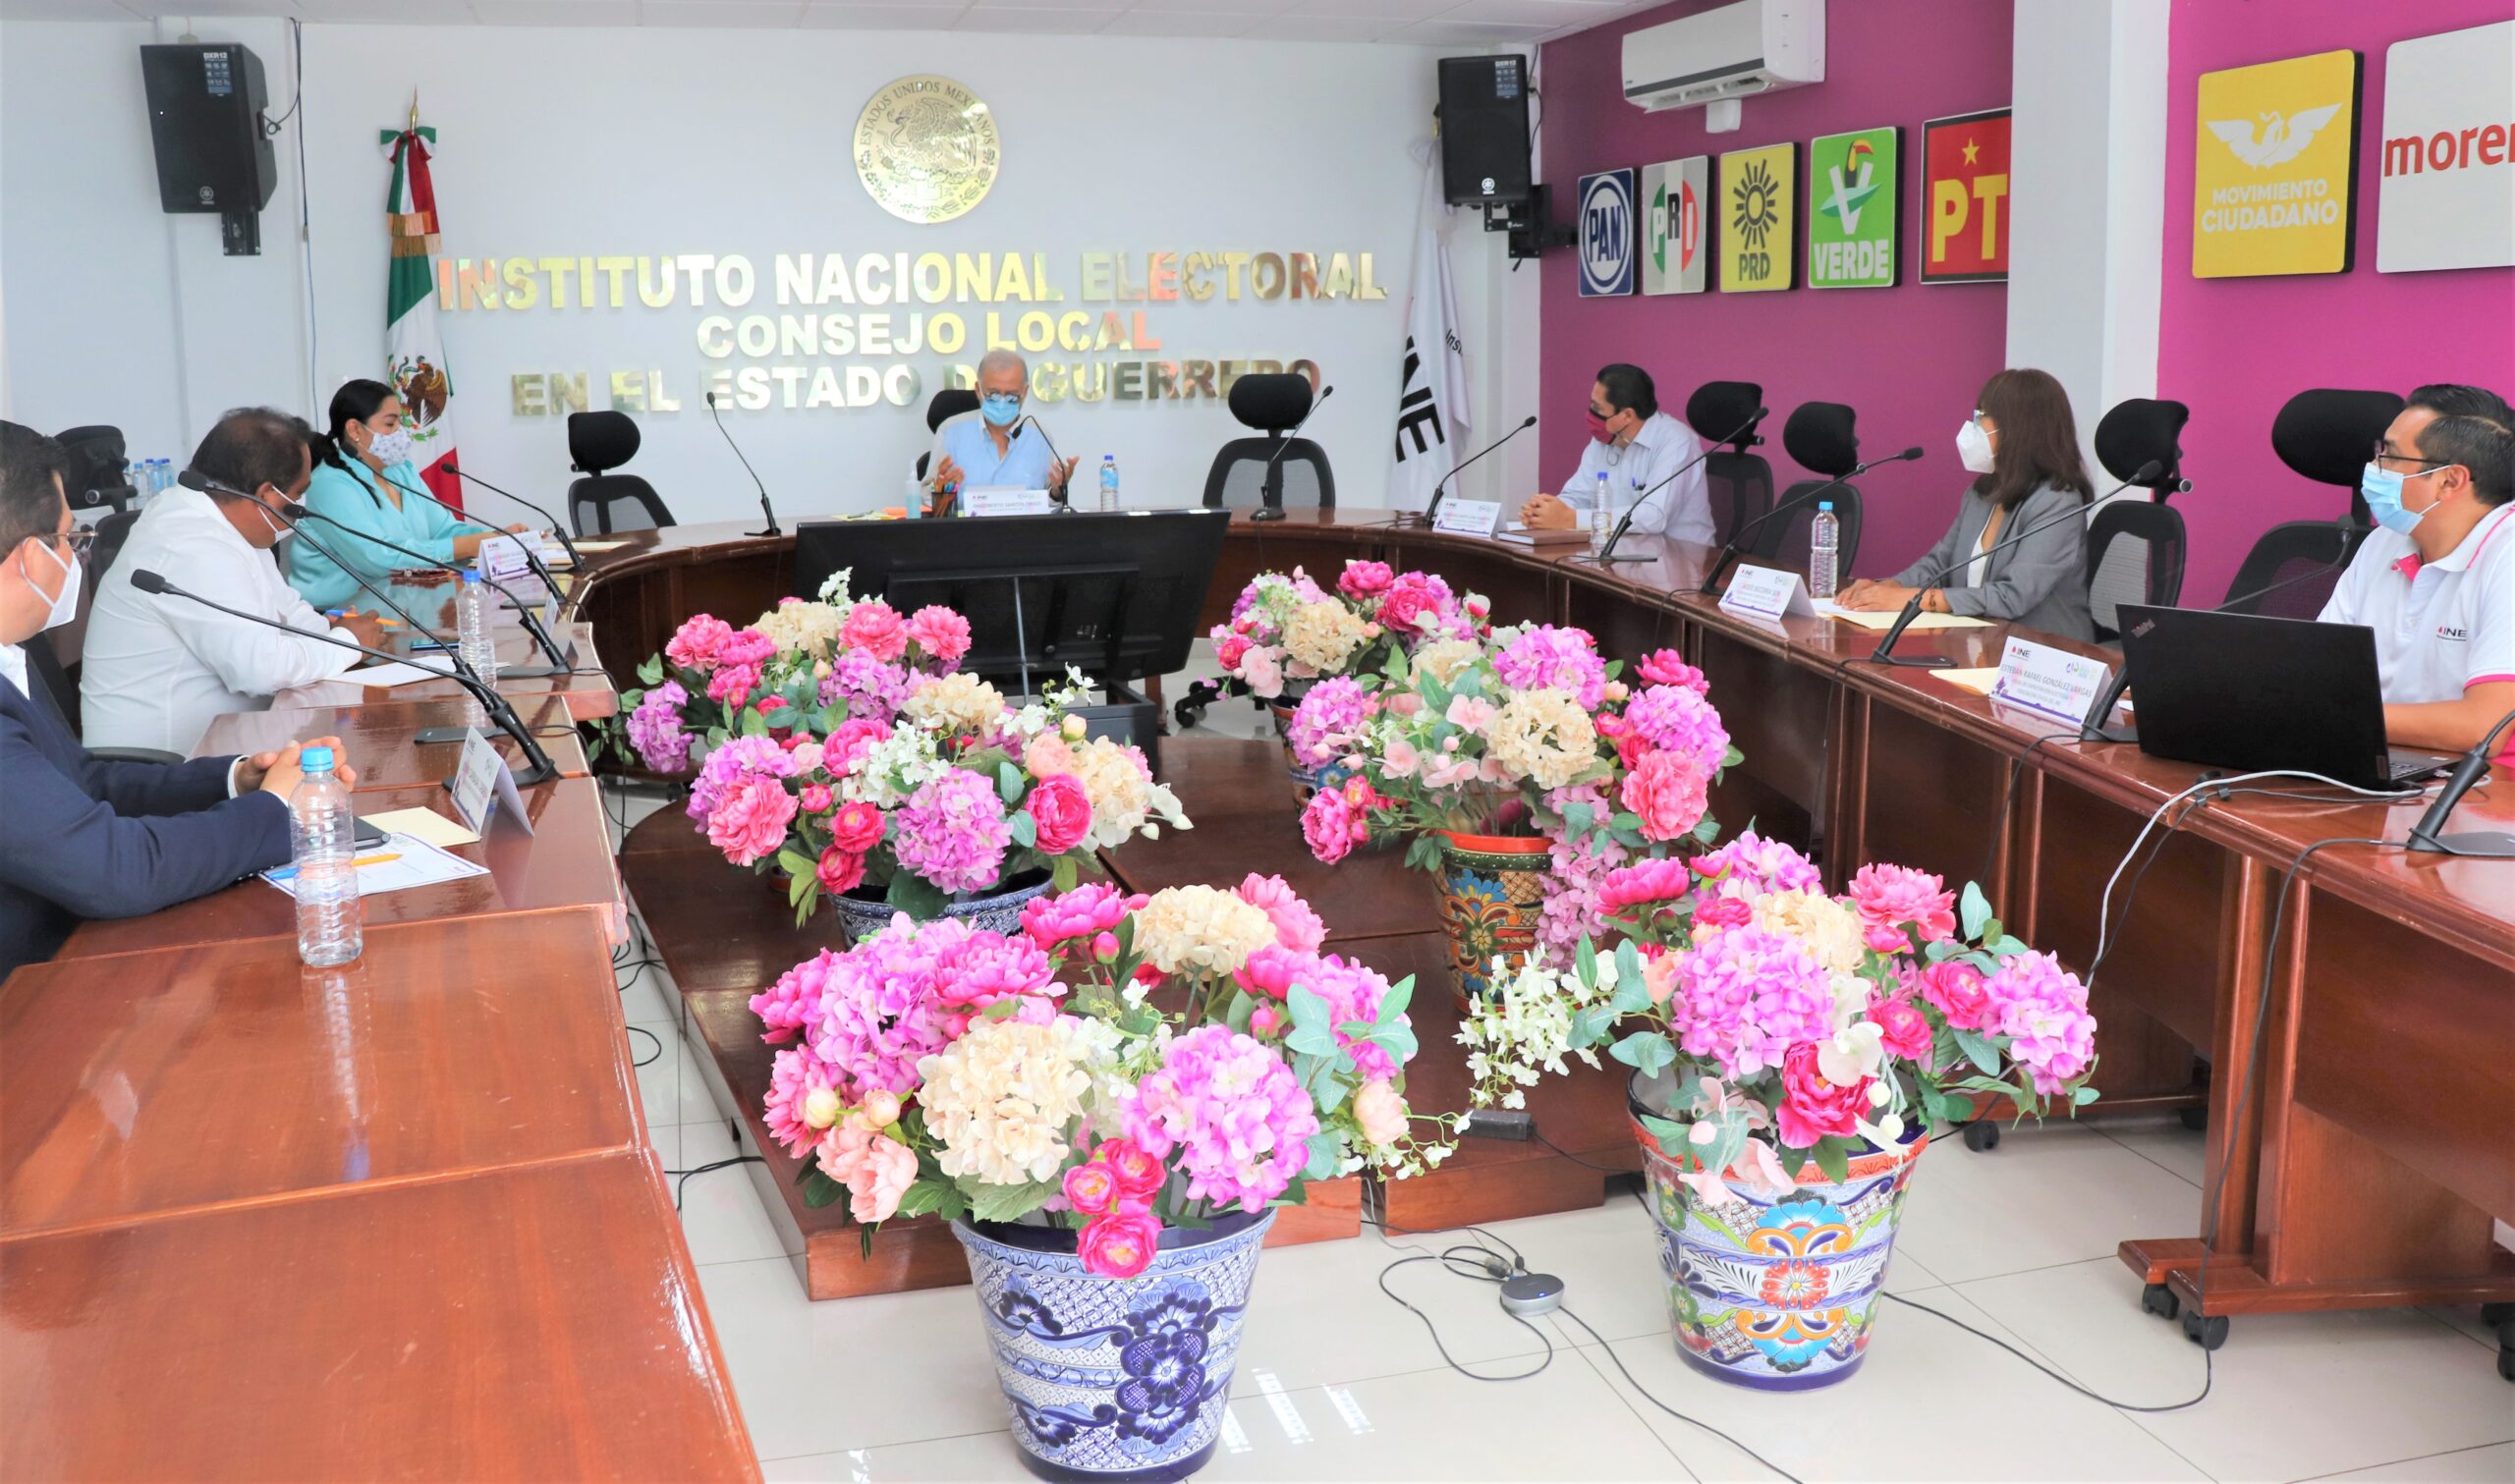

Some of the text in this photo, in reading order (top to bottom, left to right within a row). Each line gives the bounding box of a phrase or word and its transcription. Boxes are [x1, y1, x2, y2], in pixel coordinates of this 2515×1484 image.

[860, 81, 994, 145] ESTADOS UNIDOS MEXIANOS
[2383, 122, 2515, 178] more
[2201, 199, 2339, 233] CIUDADANO
[2211, 178, 2328, 205] MOVIMIENTO
[1589, 204, 1621, 263] PAN
[1651, 192, 1694, 254] PRI
[1931, 174, 2008, 262] PT
[437, 250, 1387, 310] INSTITUTO NACIONAL ELECTORAL
[1738, 251, 1771, 282] PRD
[1814, 239, 1889, 281] VERDE
[696, 309, 1164, 359] CONSEJO LOCAL
[511, 371, 589, 417] EN
[610, 369, 682, 412] EL
[699, 363, 922, 412] ESTADO
[2017, 646, 2032, 657] INE
[2443, 628, 2467, 637] INE
